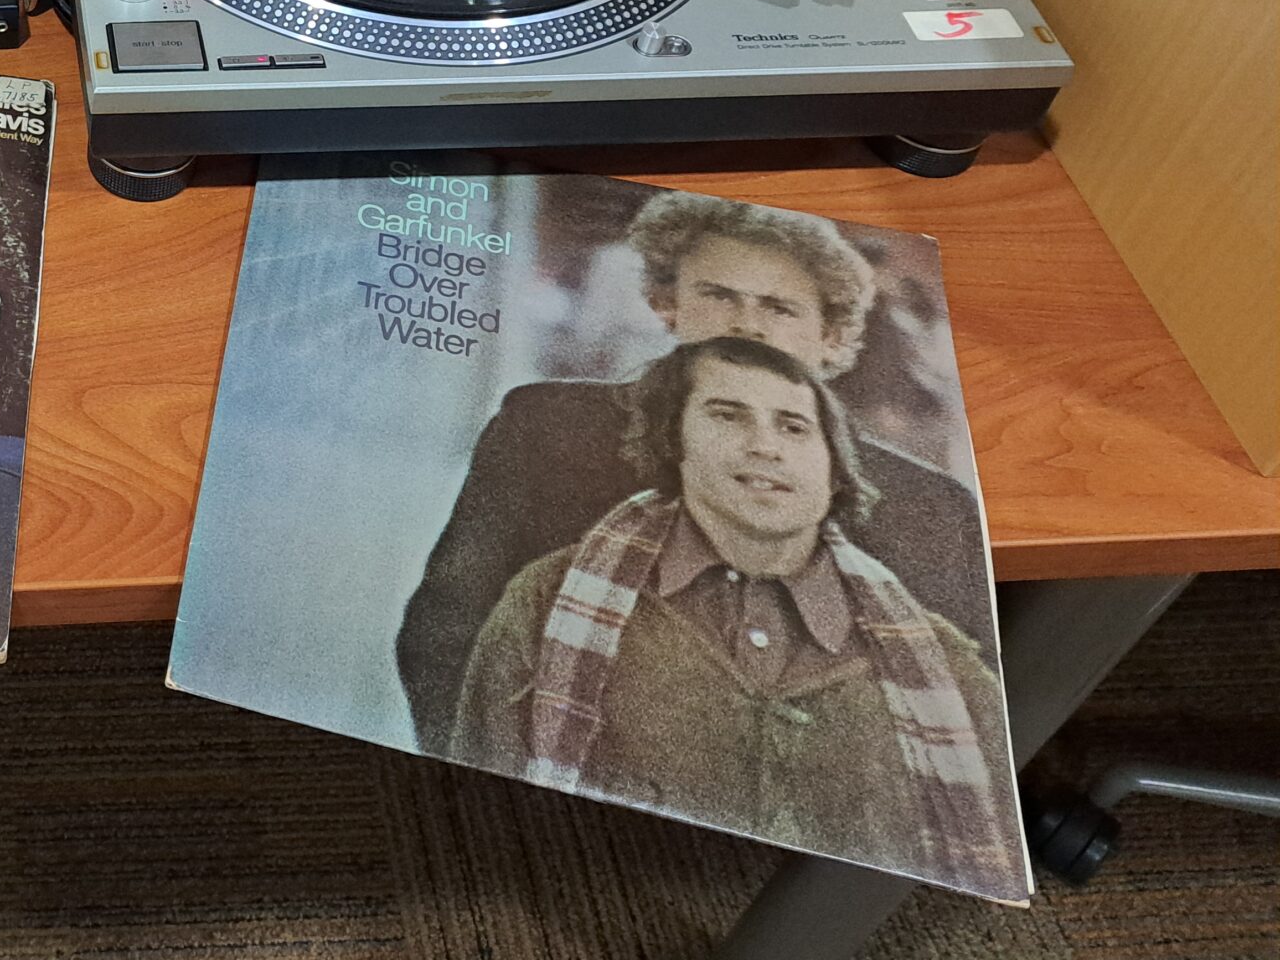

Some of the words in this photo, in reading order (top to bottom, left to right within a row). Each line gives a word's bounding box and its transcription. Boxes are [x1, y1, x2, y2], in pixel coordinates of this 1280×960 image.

[731, 33, 800, 42] Technics
[933, 11, 985, 39] 5
[161, 40, 183, 48] stop
[1, 90, 39, 102] 7185
[19, 133, 44, 146] Way
[389, 160, 489, 202] Simon
[406, 192, 468, 221] and
[357, 204, 511, 255] Garfunkel
[377, 232, 487, 277] Bridge
[388, 262, 470, 300] Over
[357, 280, 501, 334] Troubled
[377, 312, 480, 357] Water
